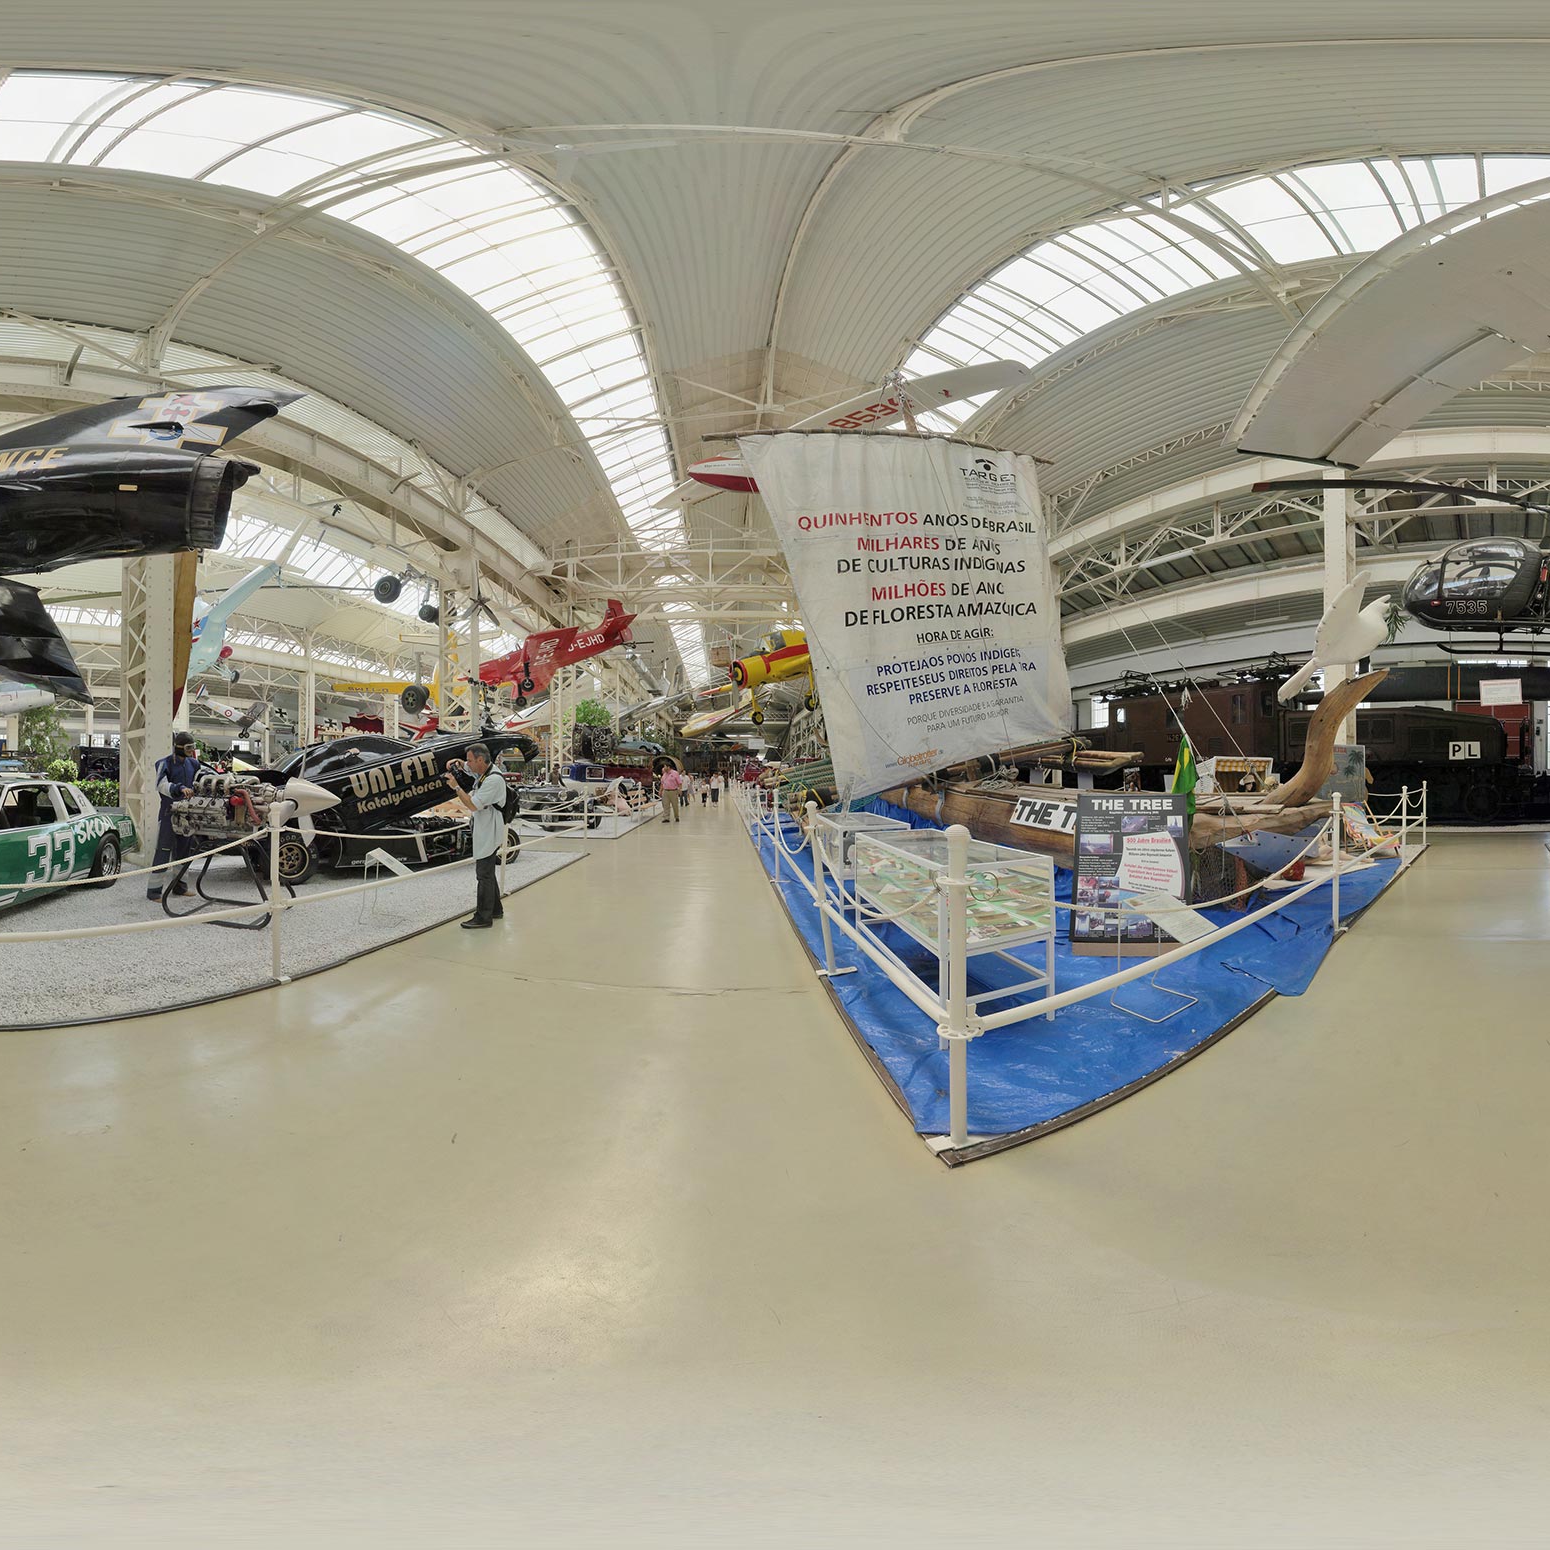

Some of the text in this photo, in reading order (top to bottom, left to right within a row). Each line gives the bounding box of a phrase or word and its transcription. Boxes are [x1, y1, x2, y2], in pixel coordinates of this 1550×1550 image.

[798, 512, 918, 532] QUINHENTOS
[923, 514, 968, 526] ANOS
[989, 521, 1035, 533] BRASIL
[857, 536, 940, 552] MILHARES
[945, 538, 967, 550] DE
[837, 558, 861, 574] DE
[867, 557, 950, 573] CULTURAS
[872, 580, 946, 601] MILHÕES
[951, 582, 970, 596] DE
[845, 610, 869, 627] DE
[873, 604, 953, 625] FLORESTA
[1445, 600, 1488, 615] 7535
[916, 627, 994, 644] HORA DE AGIR:
[946, 651, 977, 665] POVOS
[949, 665, 988, 681] DIREITOS
[991, 662, 1016, 675] PELA
[909, 677, 1018, 705] PRESERVE A FLORESTA
[907, 712, 937, 726] PORQUE
[939, 703, 981, 719] DIVERSIDADE
[991, 695, 1024, 709] GARANTIA
[926, 708, 1010, 733] PARA UM FUTURO MELHOR
[357, 779, 443, 814] Katalysatoren
[1091, 799, 1173, 811] THE TREE
[1016, 800, 1059, 827] THE
[22, 829, 76, 892] 33
